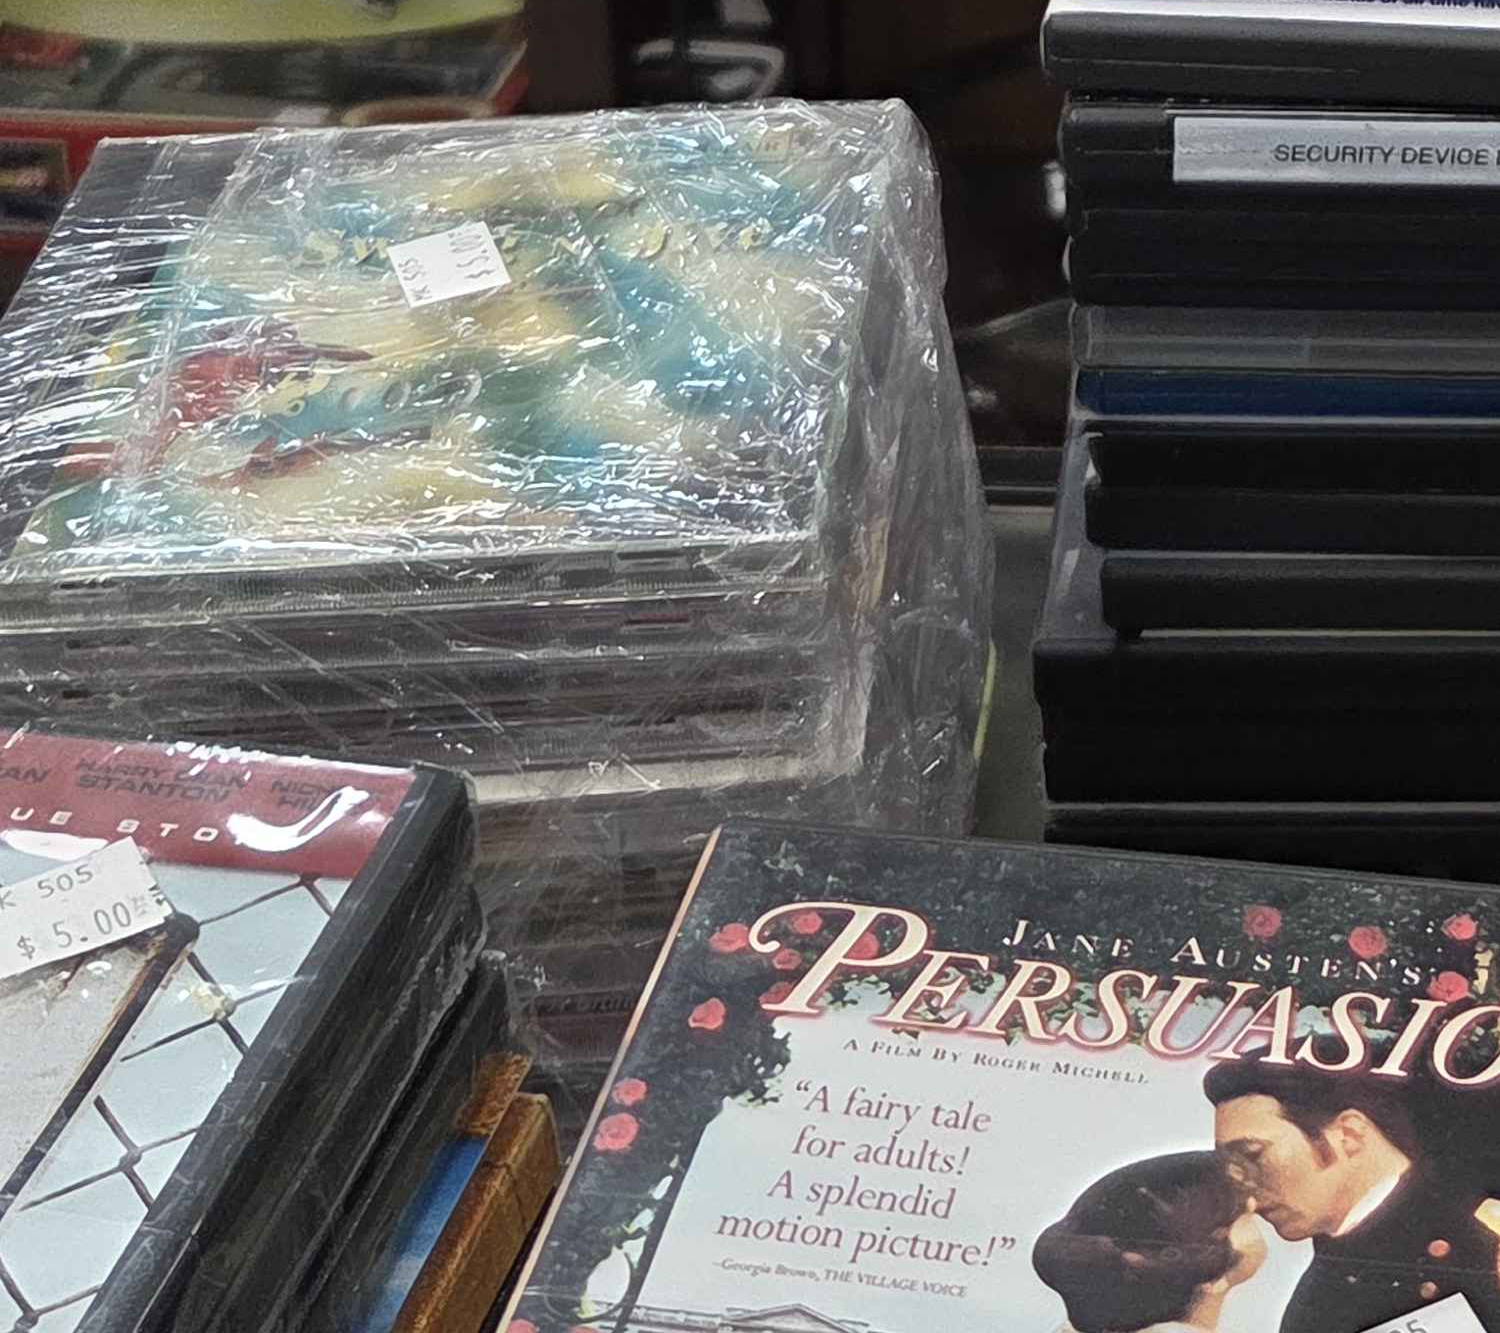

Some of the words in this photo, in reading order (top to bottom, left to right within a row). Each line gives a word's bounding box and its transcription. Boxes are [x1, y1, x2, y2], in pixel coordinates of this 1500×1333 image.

[1274, 143, 1395, 164] SECURITY
[1401, 146, 1489, 167] DEVICE
[77, 776, 230, 803] STANTON
[37, 862, 95, 899] 505
[1002, 918, 1137, 960] JANE
[1172, 932, 1426, 988] AUSTEN'S
[841, 1037, 862, 1054] A
[870, 1040, 922, 1061] FILM
[932, 1046, 964, 1064] BY
[973, 1051, 1042, 1074] ROGER
[1051, 1060, 1151, 1086] MICHELL
[843, 1086, 920, 1134] fairy
[931, 1101, 992, 1134] tale
[791, 1124, 847, 1160] for
[853, 1135, 971, 1177] adults!
[766, 1169, 795, 1200] A
[805, 1175, 957, 1220] splendid
[716, 1213, 844, 1250] motion
[823, 1268, 854, 1284] THE
[856, 1271, 920, 1292] VILLAGE
[922, 1279, 969, 1299] VOICE
